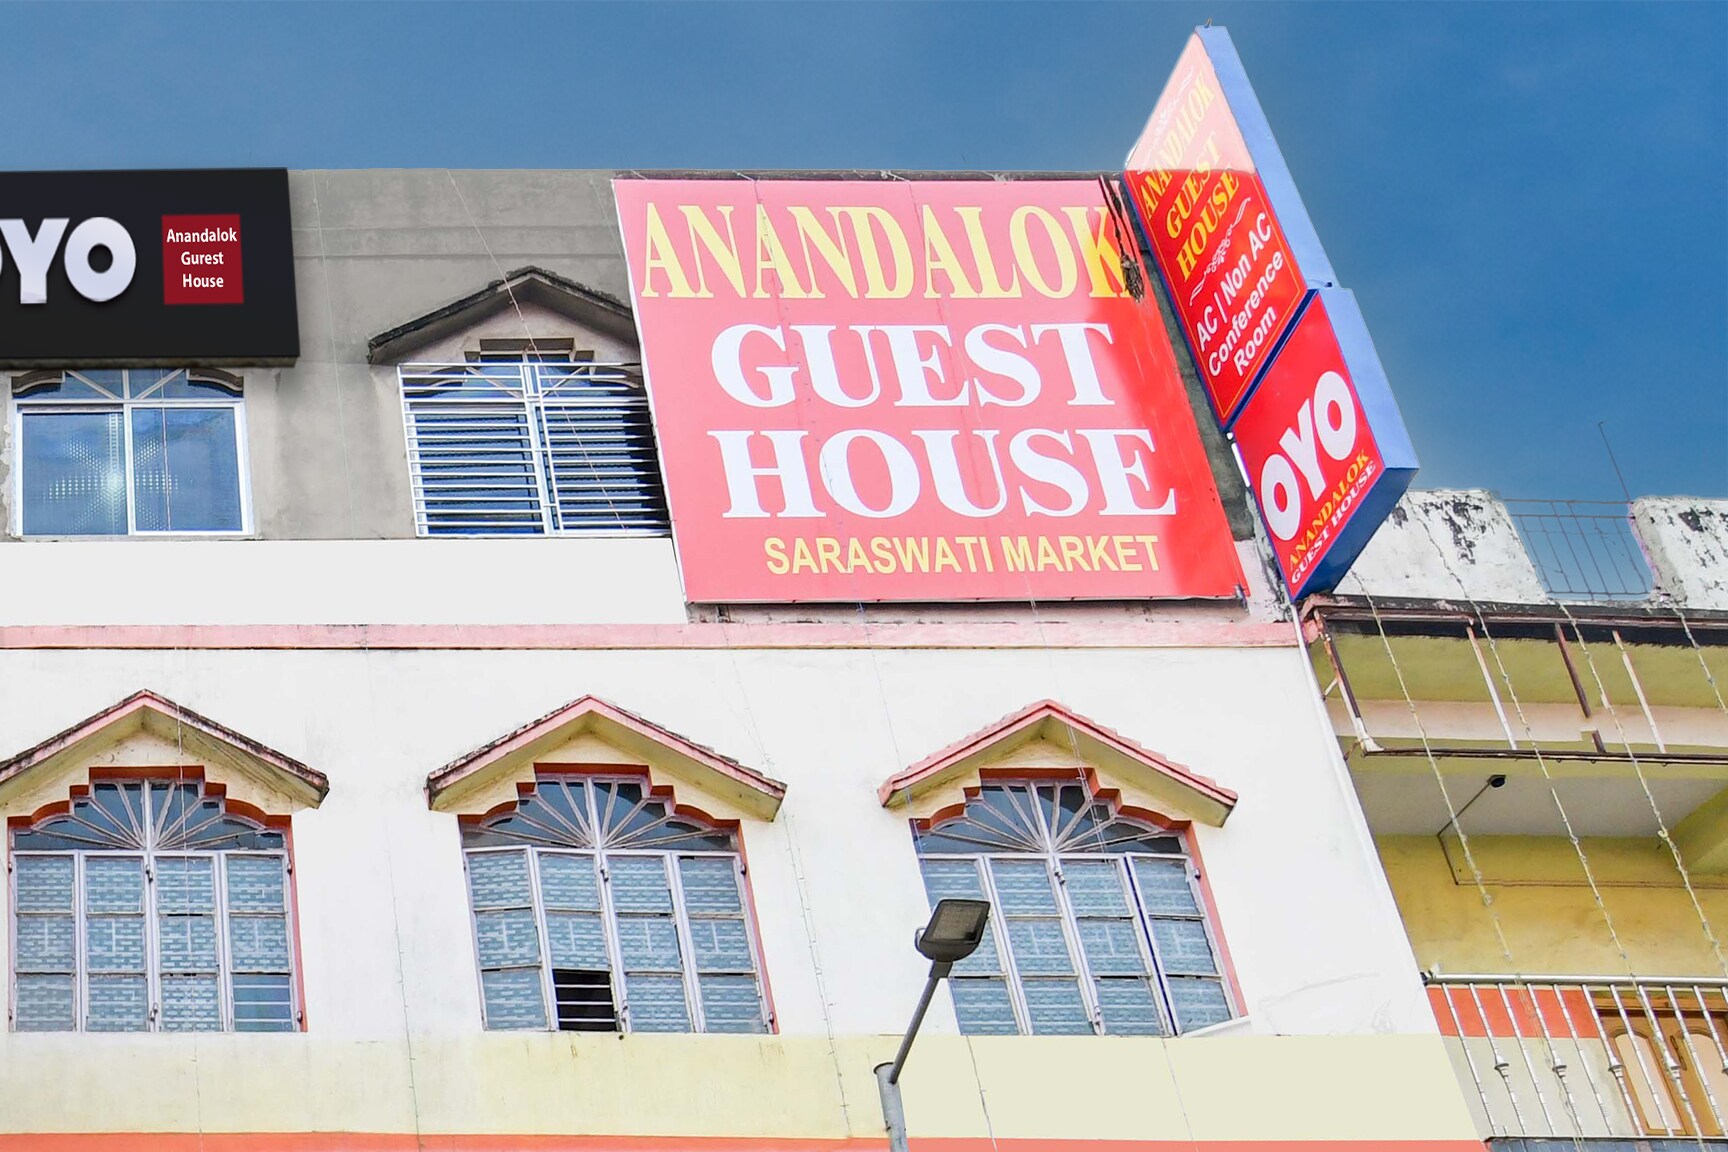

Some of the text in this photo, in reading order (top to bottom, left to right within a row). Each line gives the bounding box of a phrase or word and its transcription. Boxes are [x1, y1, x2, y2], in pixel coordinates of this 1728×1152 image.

[1140, 72, 1216, 220] ANANDALOK
[1166, 131, 1224, 239] GUEST
[167, 227, 237, 243] Anandalok
[181, 251, 224, 267] Gurest
[642, 202, 1129, 299] ANANDALOK
[1176, 164, 1240, 282] HOUSE
[182, 273, 224, 288] House
[1196, 307, 1218, 352] AC
[1222, 251, 1251, 308] Non
[1248, 212, 1273, 254] AC
[1208, 250, 1283, 377] Conference
[711, 323, 1114, 407] GUEST
[1233, 306, 1276, 377] Room
[708, 428, 1177, 519] HOUSE
[1261, 370, 1356, 541] OYO
[765, 534, 1159, 575] SARASWATI MARKET
[1287, 449, 1369, 571] ANANDALOK
[1291, 460, 1377, 585] GUEST HOUSE
